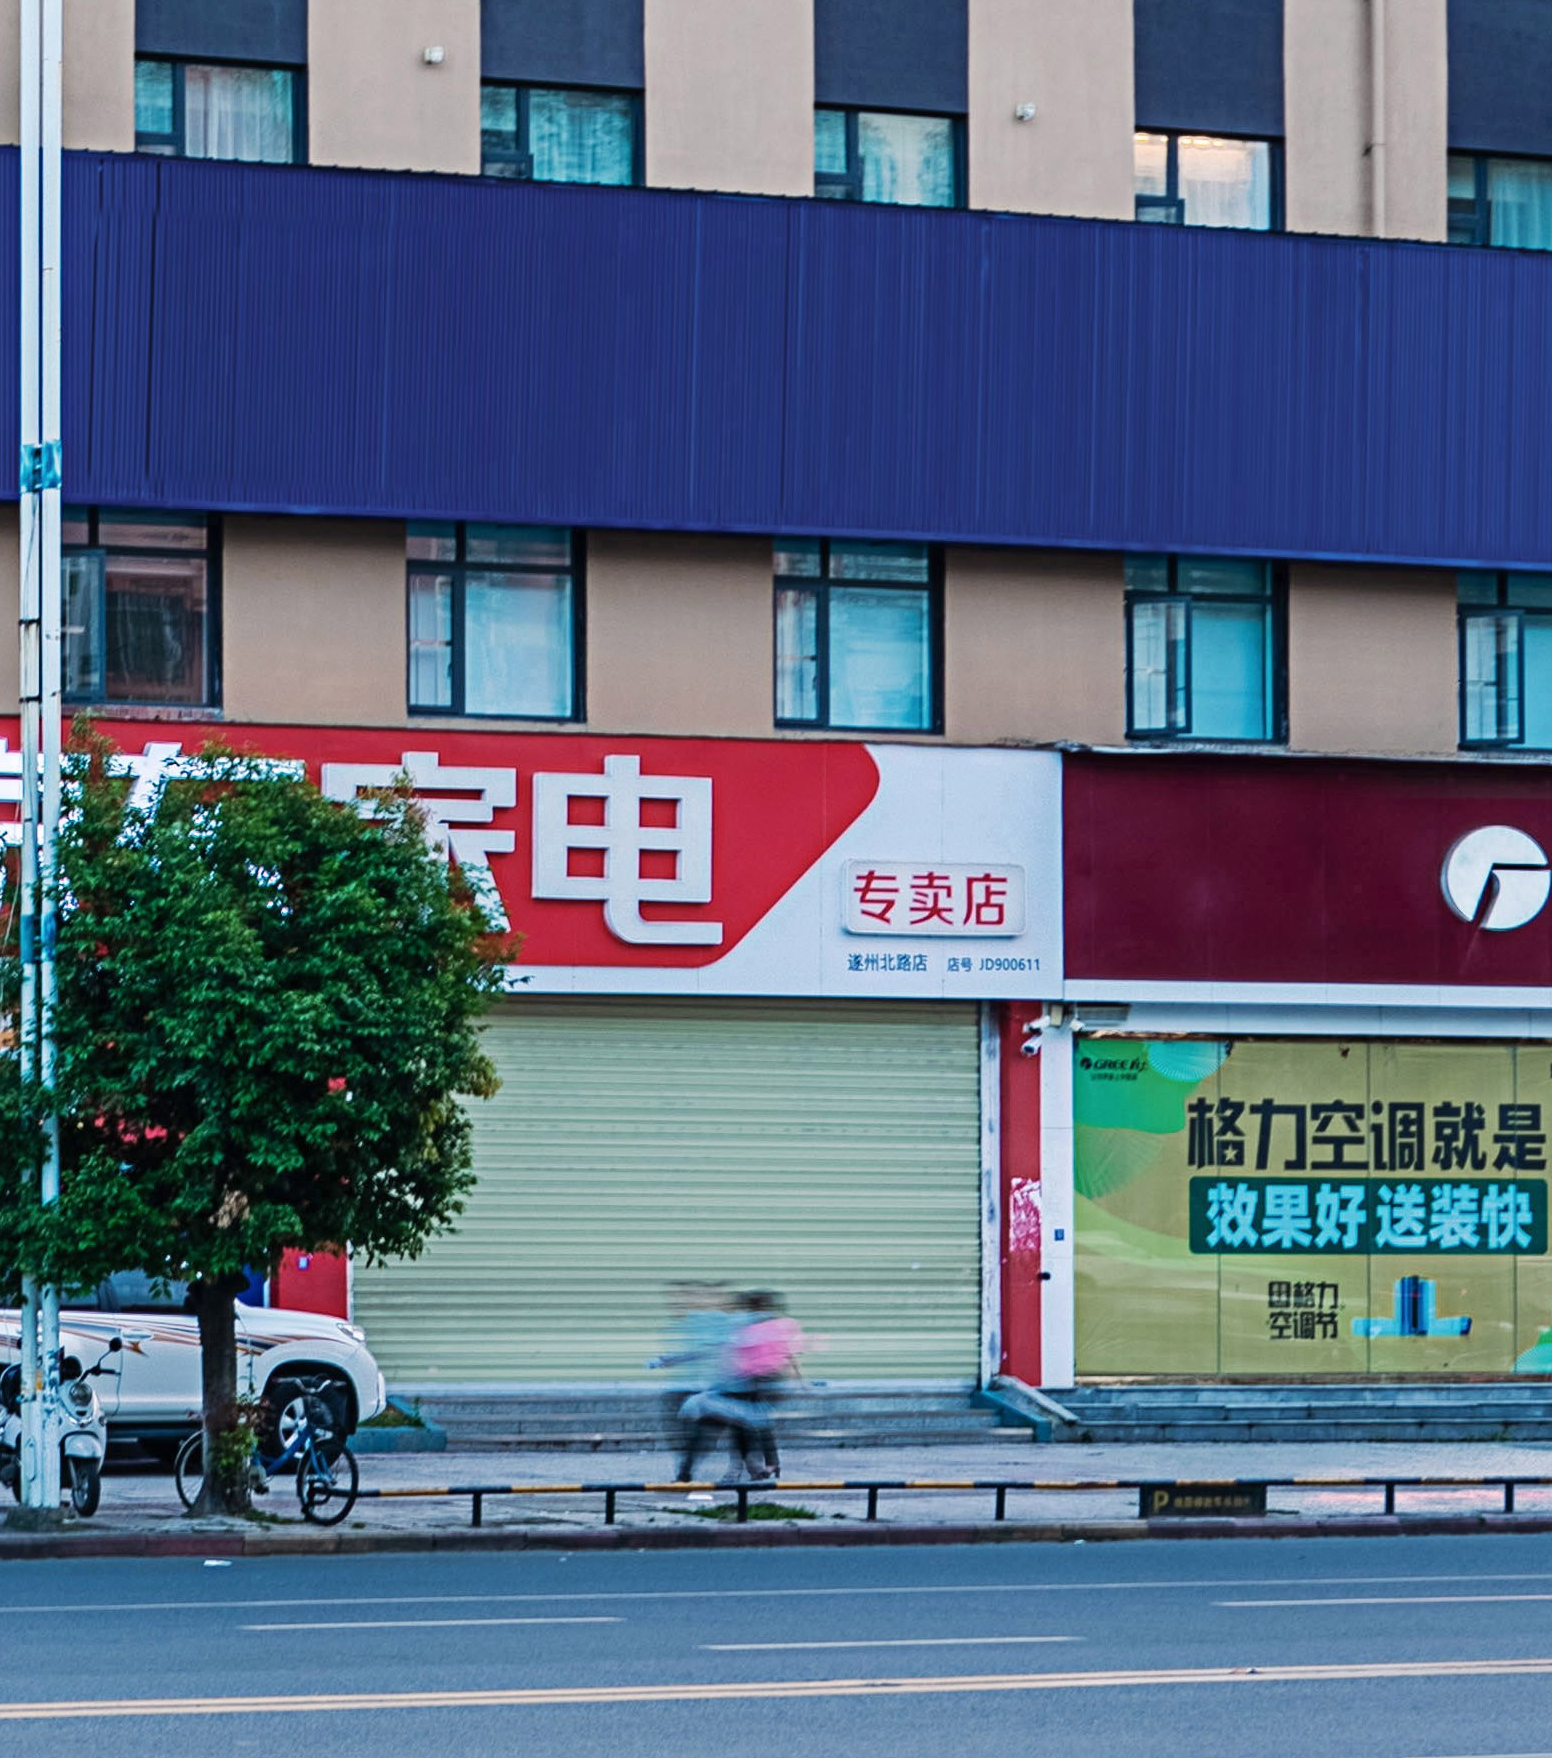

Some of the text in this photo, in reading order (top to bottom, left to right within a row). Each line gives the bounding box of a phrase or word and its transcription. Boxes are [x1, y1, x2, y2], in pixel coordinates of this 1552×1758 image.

[854, 869, 1008, 926] 专卖店
[848, 953, 1041, 972] 遂州北路店 店号 JD900611
[1188, 1098, 1548, 1172] 格力空调就是
